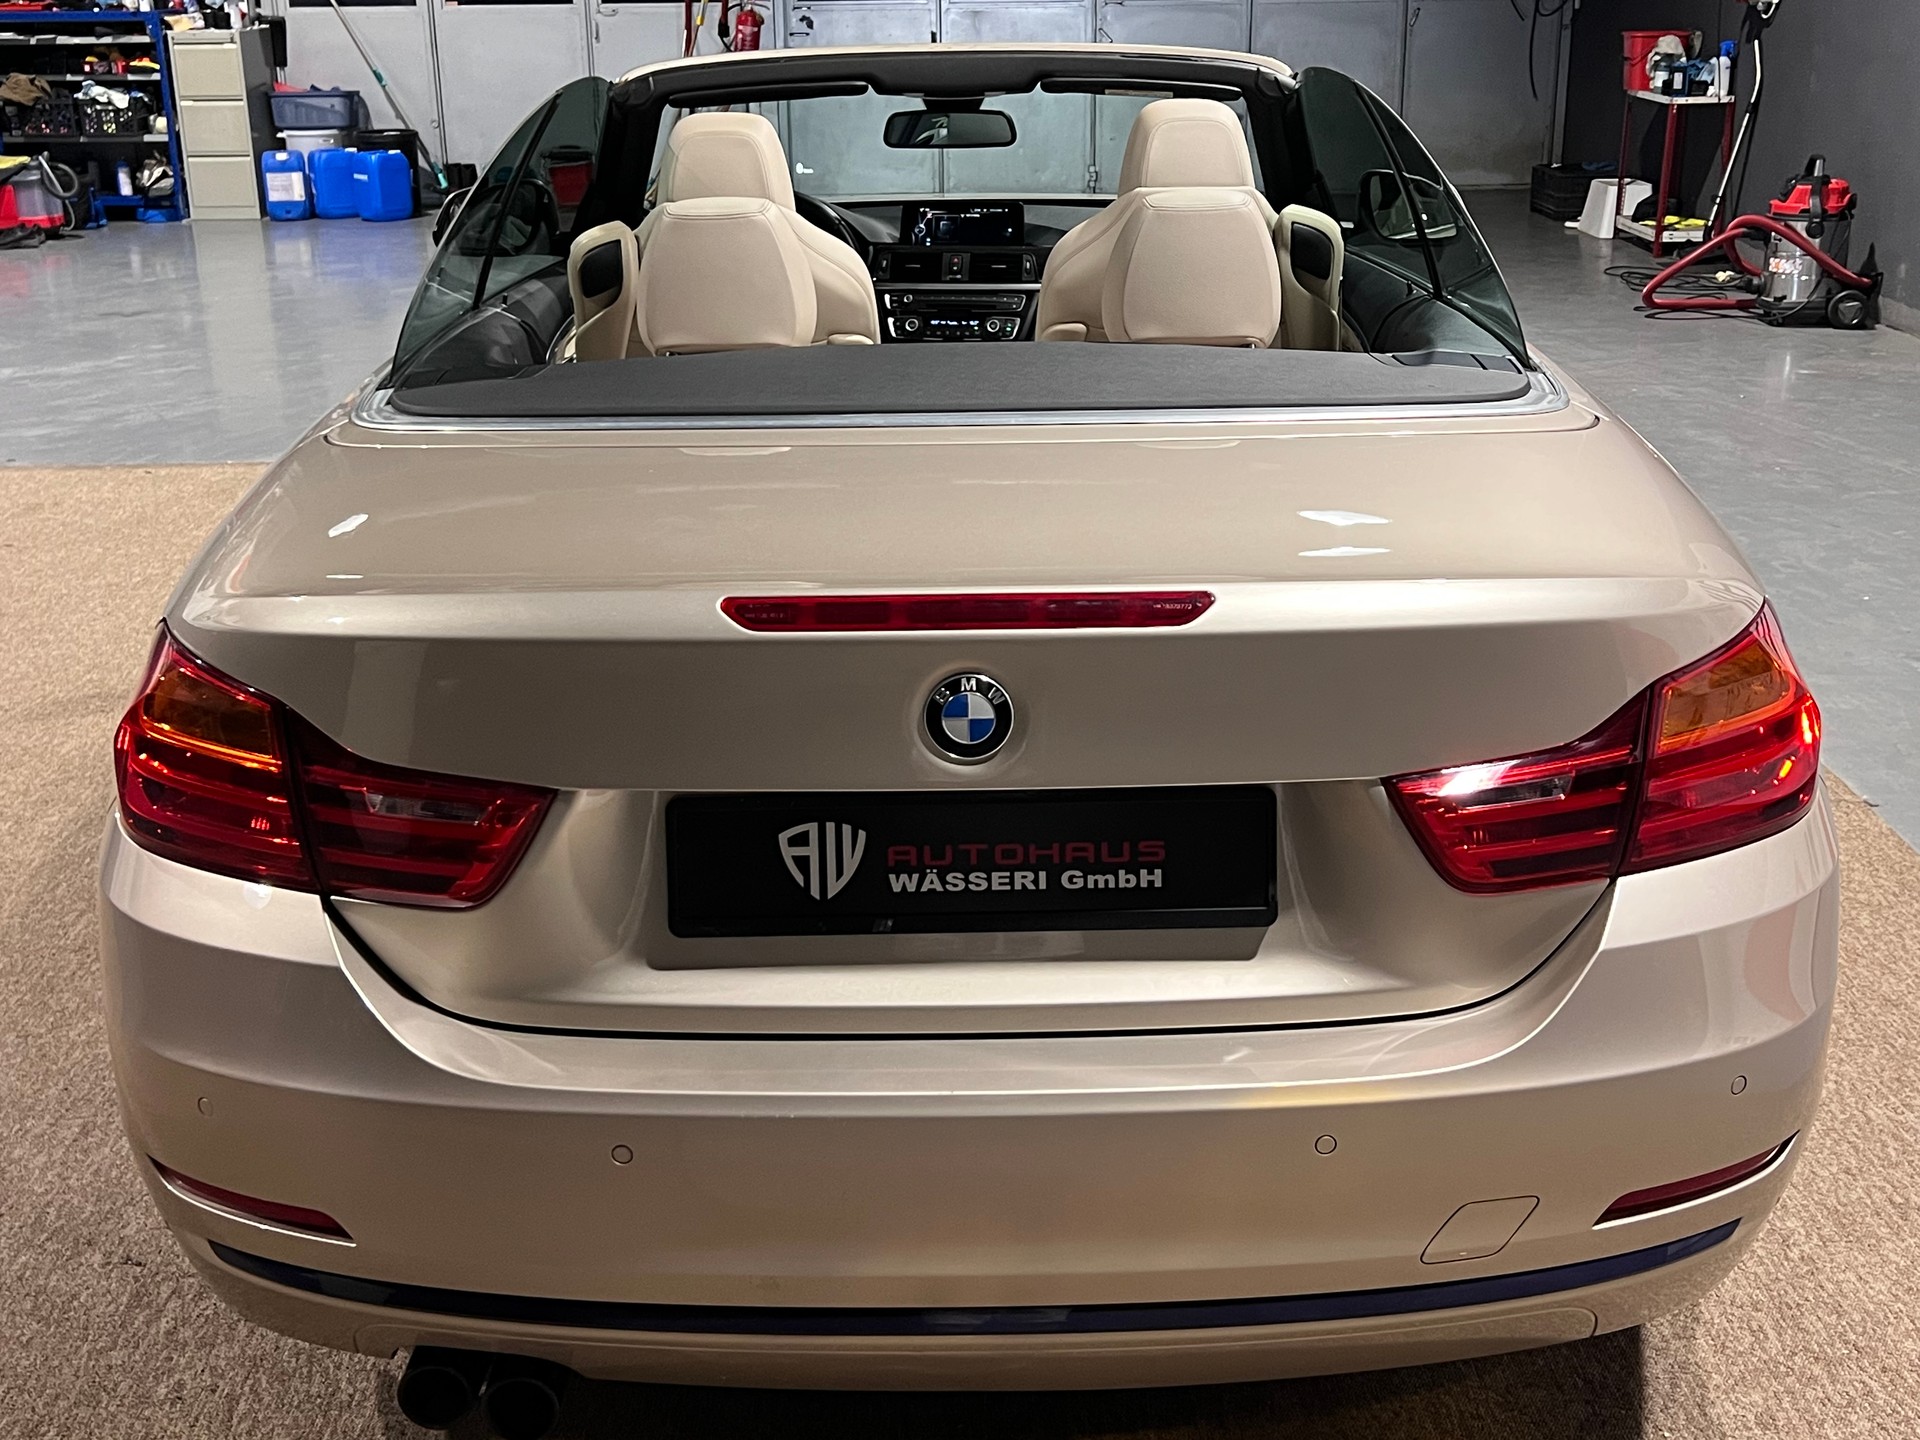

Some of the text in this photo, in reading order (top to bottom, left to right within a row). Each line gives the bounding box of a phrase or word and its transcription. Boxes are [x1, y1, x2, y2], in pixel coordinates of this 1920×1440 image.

[933, 677, 1006, 705] BMW
[778, 821, 867, 900] AW
[887, 840, 1166, 867] AUTOHAUS
[888, 869, 1163, 892] WÄSSERI GmbH
